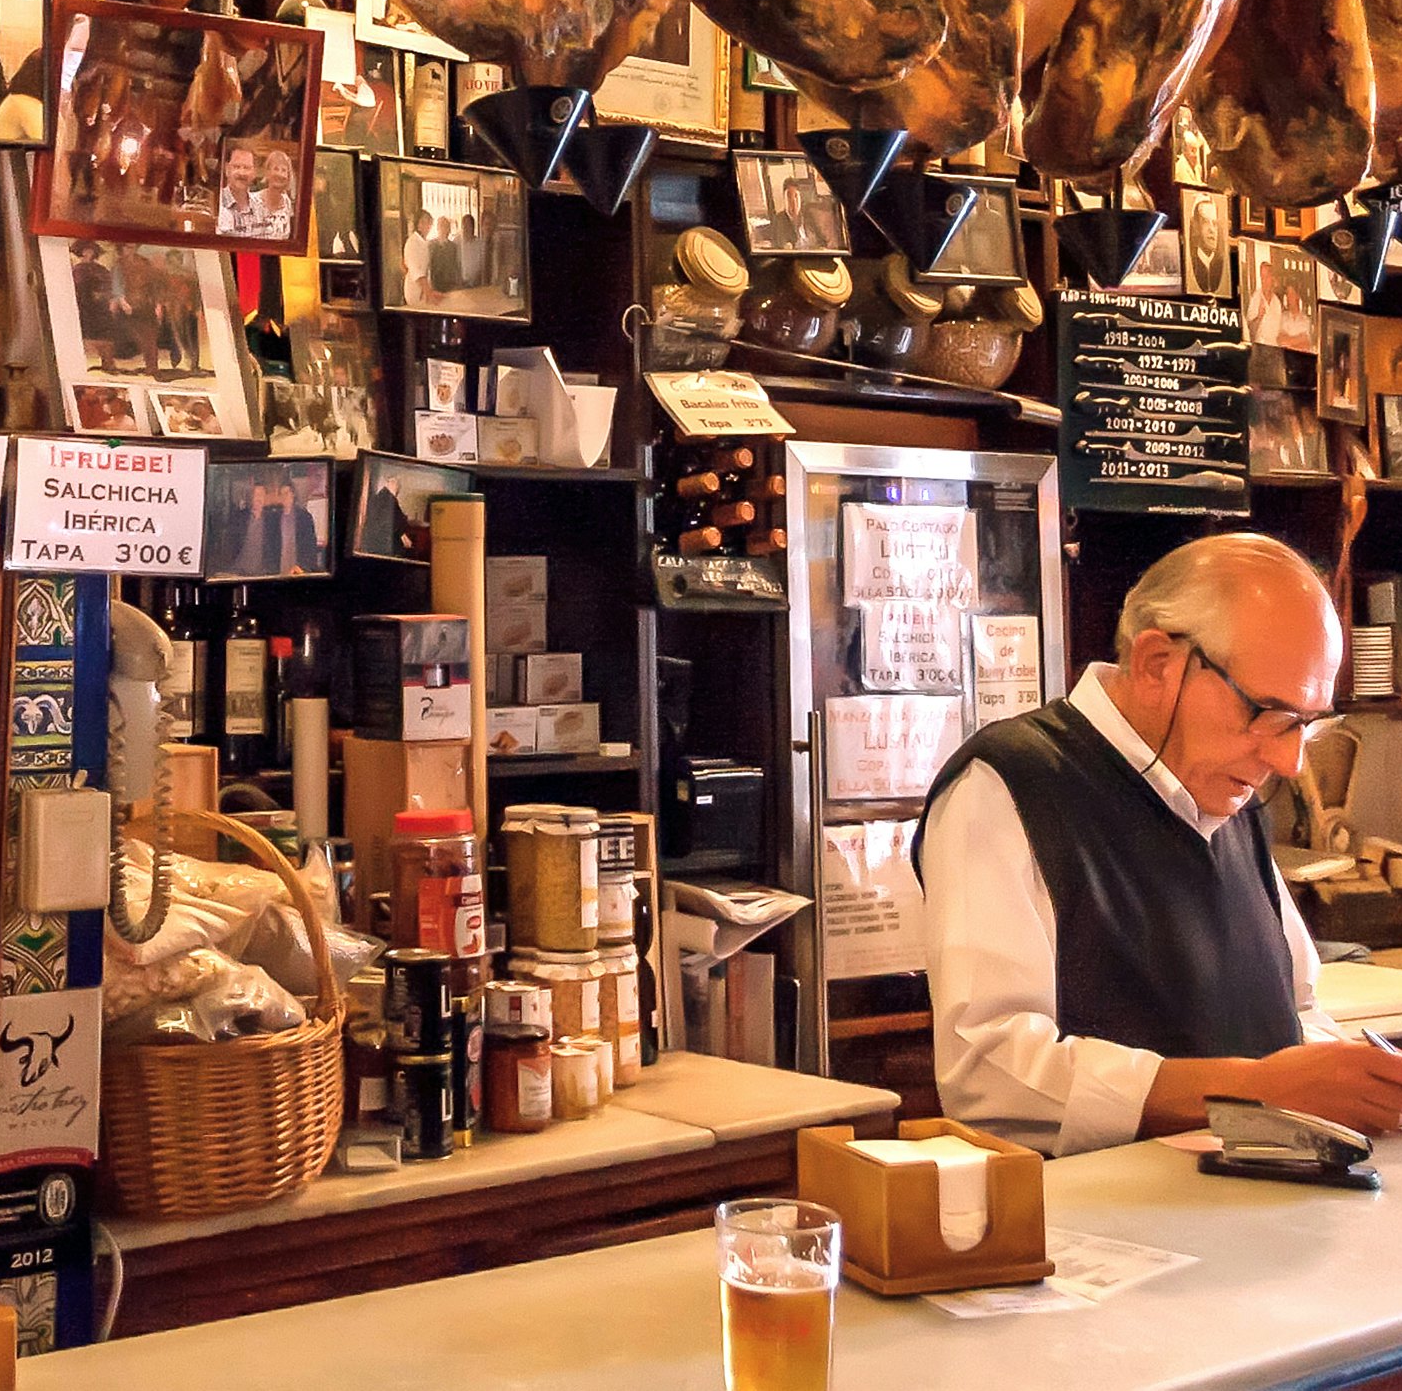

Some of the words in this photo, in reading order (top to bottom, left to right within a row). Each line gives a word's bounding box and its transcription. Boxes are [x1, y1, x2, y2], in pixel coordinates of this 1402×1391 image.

[680, 398, 729, 410] Bacalao
[699, 418, 732, 430] Tapa
[1105, 417, 1176, 434] 2007-2010
[1144, 440, 1205, 458] 2009-2012
[44, 477, 180, 505] SALCHICHA
[63, 508, 157, 535] IBÉRICA
[21, 539, 86, 563] TAPA
[115, 543, 172, 565] 3'00
[178, 546, 194, 565] €
[999, 646, 1015, 659] de
[978, 692, 1006, 708] Tapa
[10, 1247, 54, 1269] 2012
